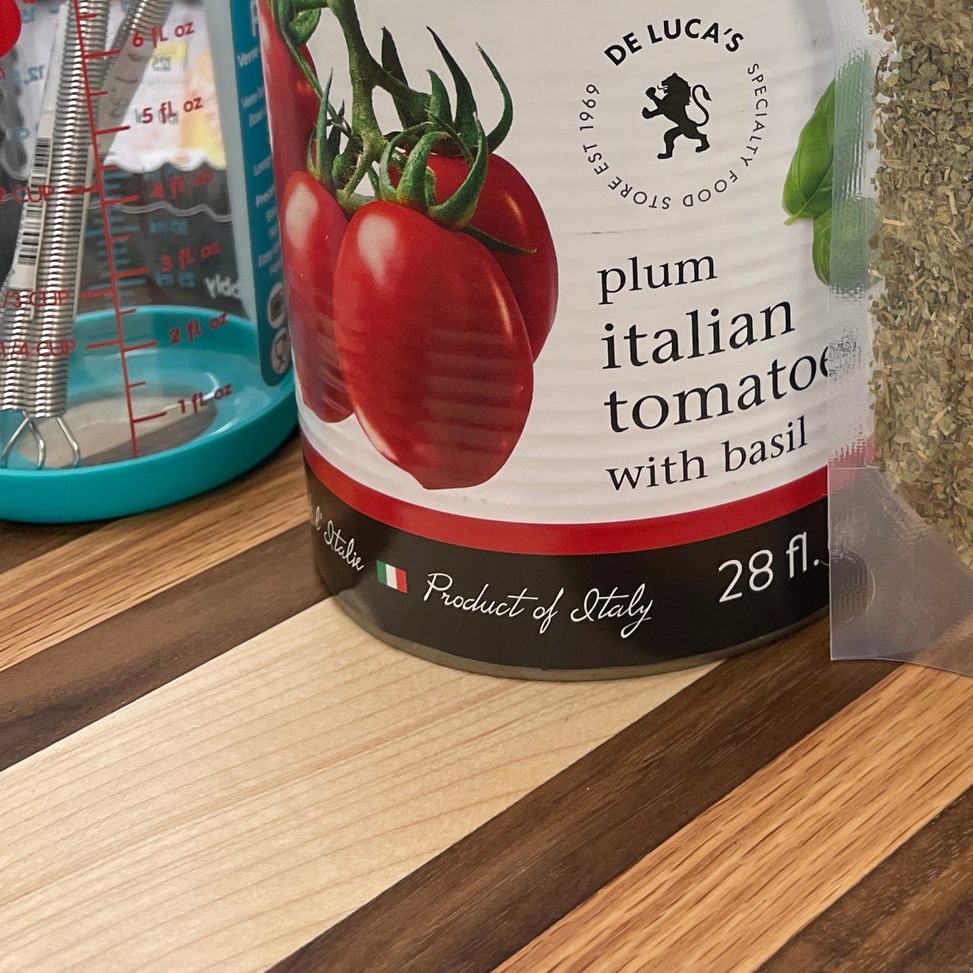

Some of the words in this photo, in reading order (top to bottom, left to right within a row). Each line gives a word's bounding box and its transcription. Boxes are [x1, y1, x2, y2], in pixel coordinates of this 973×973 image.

[132, 30, 144, 48] 6
[175, 21, 194, 38] oz
[604, 32, 642, 66] DE
[647, 18, 744, 52] LUCA'S
[142, 107, 154, 124] 5
[183, 96, 203, 112] oz
[579, 84, 600, 131] 1969
[740, 63, 768, 167] SPECIALTY
[583, 144, 610, 175] EST
[13, 185, 55, 203] CUP
[608, 176, 671, 210] STORE
[683, 170, 738, 207] FOOD
[160, 254, 173, 273] 3
[597, 253, 718, 305] plum
[30, 289, 70, 308] CUP
[37, 338, 76, 357] CUP
[169, 328, 182, 345] 2
[602, 299, 795, 369] italian
[178, 398, 187, 414] 1
[604, 346, 829, 433] tomato
[606, 450, 708, 491] with
[722, 416, 808, 472] basil
[718, 549, 774, 603] 28
[786, 531, 819, 578] fl.
[424, 572, 539, 619] Product
[533, 588, 565, 634] of
[569, 583, 653, 639] Italy
